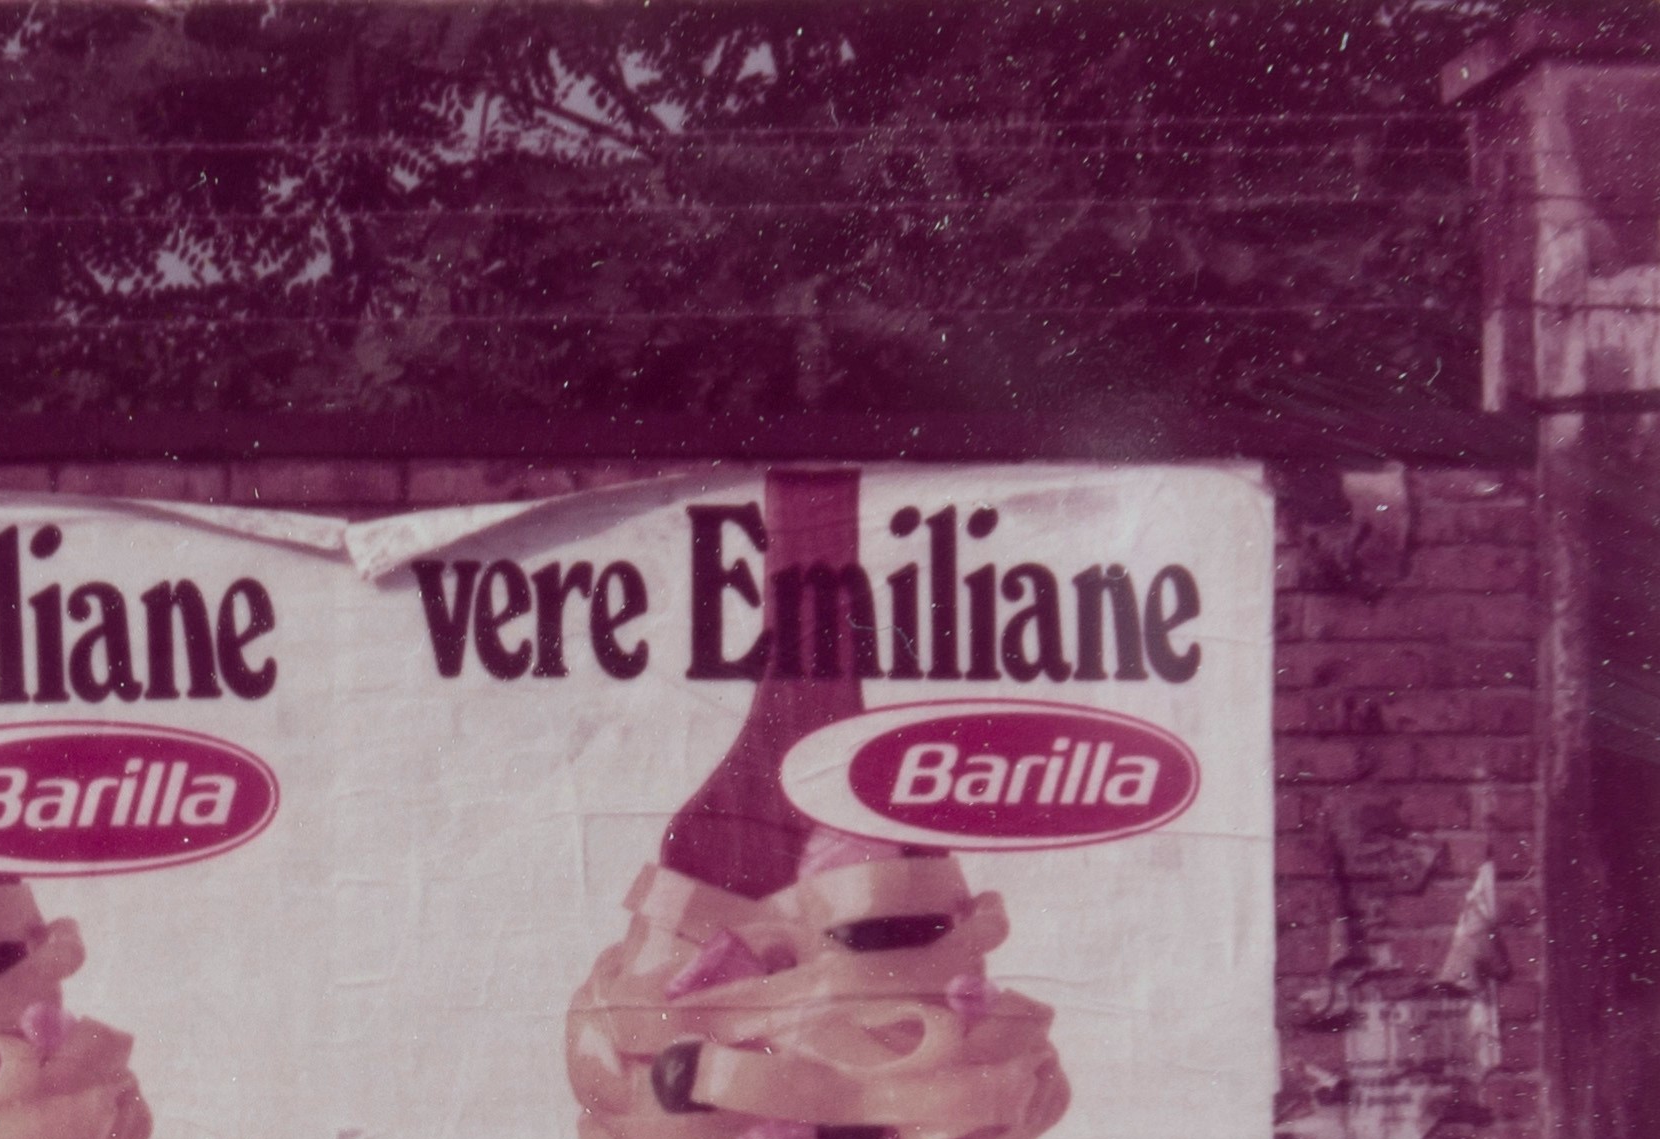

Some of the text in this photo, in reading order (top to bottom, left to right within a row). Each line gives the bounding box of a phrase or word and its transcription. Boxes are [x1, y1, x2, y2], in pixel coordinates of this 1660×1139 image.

[412, 502, 1201, 682] vere Emiliane
[892, 737, 1160, 805] Barilla
